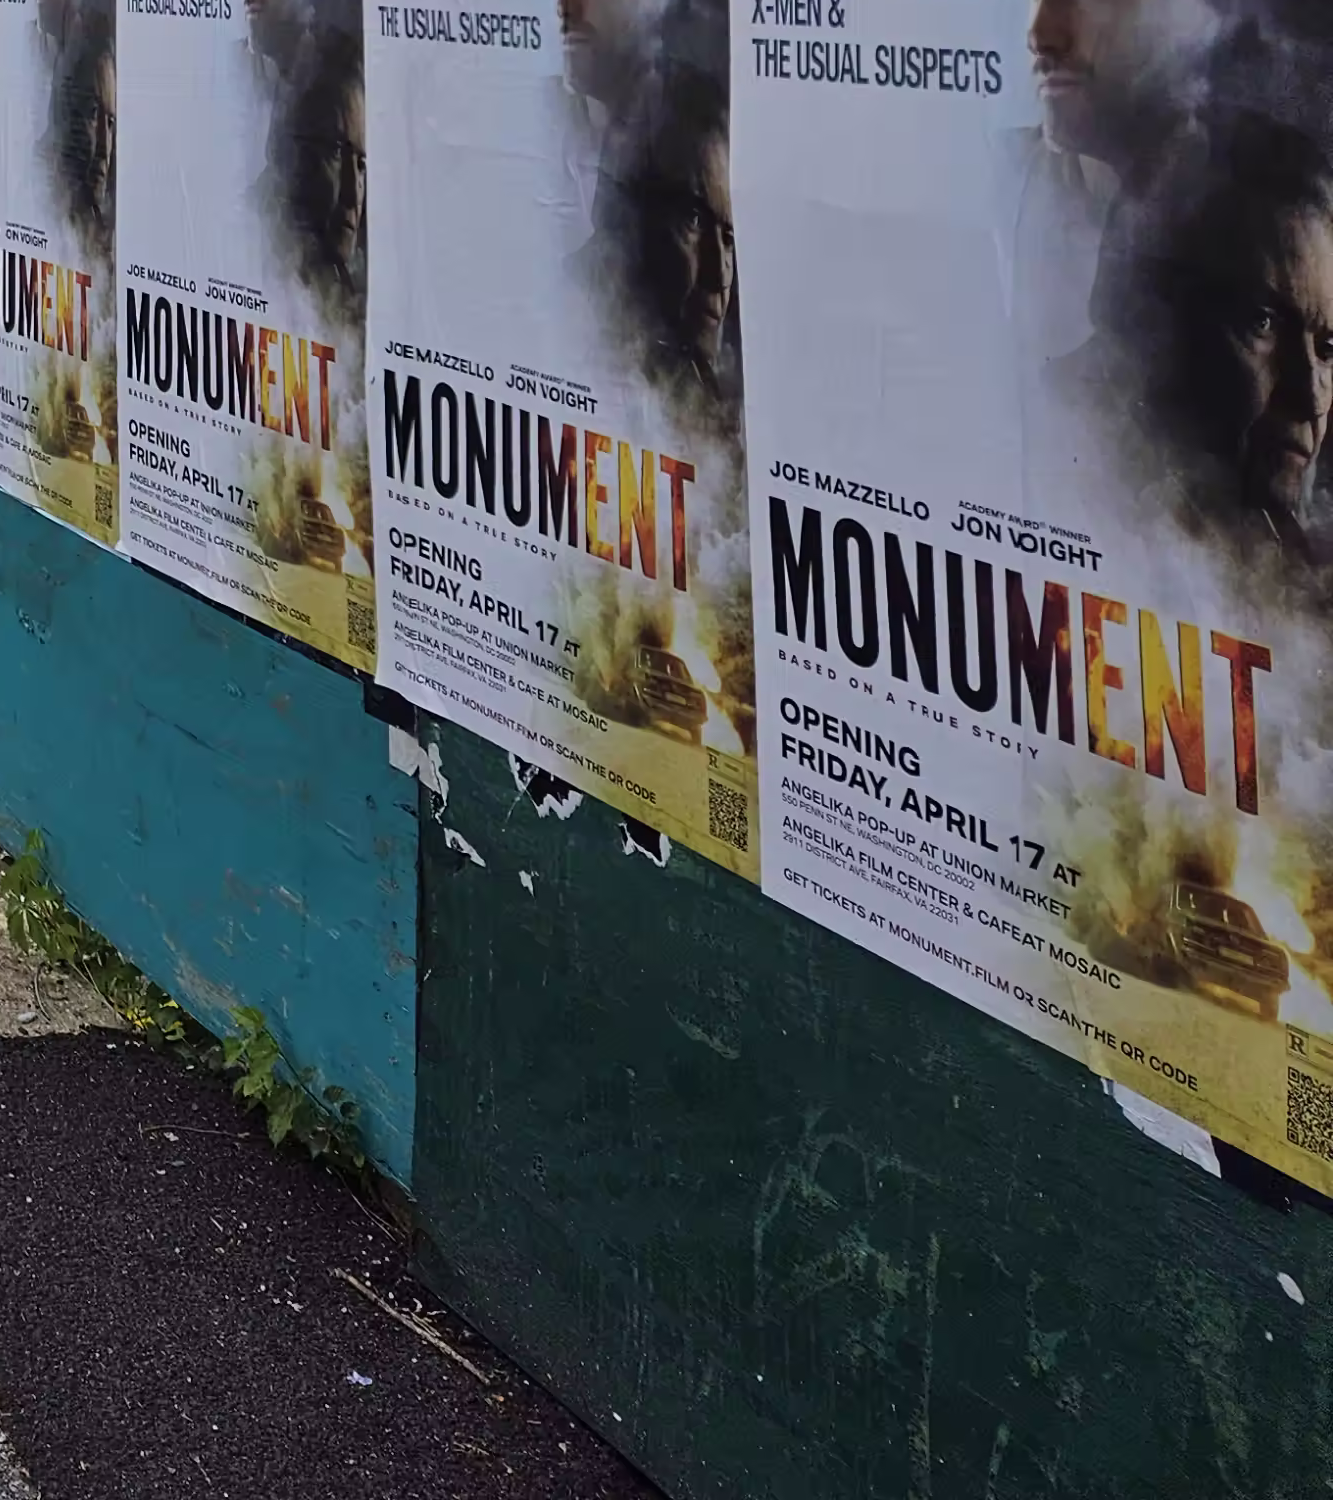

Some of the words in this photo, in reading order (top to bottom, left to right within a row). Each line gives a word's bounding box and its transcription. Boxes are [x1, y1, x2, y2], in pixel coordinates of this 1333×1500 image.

[752, 39, 791, 80] THE
[797, 41, 869, 86] USUAL
[874, 44, 1003, 95] SUSPECTS
[17, 393, 29, 412] 17
[126, 287, 336, 451] MONUMENT
[128, 418, 191, 458] OPENING
[129, 442, 179, 482] FRIDAY,
[181, 466, 224, 499] APRIL
[227, 484, 244, 507] 17
[383, 368, 696, 592] MONUMENT
[770, 461, 809, 485] JOE
[815, 472, 930, 521] MAZZELLO
[388, 527, 483, 582] OPENING
[951, 514, 1002, 543] JON
[1009, 528, 1102, 571] VOIGHT
[958, 501, 1005, 519] ACADEMY
[1049, 525, 1091, 544] WINNER
[390, 554, 464, 609] FRIDAY,
[469, 592, 529, 636] APRIL
[535, 618, 559, 648] 17
[768, 496, 1273, 816] MONUMENT
[778, 649, 836, 680] BASED
[849, 677, 873, 695] ON
[886, 692, 895, 704] A
[908, 701, 958, 728] TRUE
[779, 697, 922, 777] OPENING
[781, 732, 894, 811] FRIDAY,
[901, 787, 999, 853] APRIL
[1009, 834, 1047, 872] 17
[1053, 862, 1082, 890] AT
[781, 776, 855, 820] ANGELIKA
[858, 811, 916, 846] POP-UP
[919, 841, 939, 859] AT
[942, 850, 995, 886] UNION
[1000, 876, 1071, 919] MARKET
[799, 801, 825, 819] PENN
[826, 812, 837, 824] ST
[927, 862, 941, 875] DC
[944, 869, 976, 891] 20002
[783, 832, 803, 849] 2911
[805, 842, 846, 870] DISTRICT
[914, 895, 928, 910] VA
[930, 906, 959, 926] 22031
[783, 816, 855, 861] ANGELIKA
[859, 851, 893, 879] FILM
[897, 871, 959, 912] CENTER
[963, 903, 974, 919] &
[978, 909, 1021, 941] CAFE
[1022, 933, 1045, 952] AT
[1049, 943, 1121, 990] MOSAIC
[783, 868, 809, 888] GET
[811, 881, 866, 919] TICKETS
[869, 912, 886, 929] AT
[889, 921, 1010, 994] MONUMENT.FILM
[1014, 986, 1033, 1007] OR
[1037, 998, 1081, 1031] SCAN
[1081, 1020, 1117, 1049] THE
[1121, 1041, 1145, 1064] QR
[1149, 1056, 1198, 1091] CODE
[1289, 1033, 1307, 1055] R
